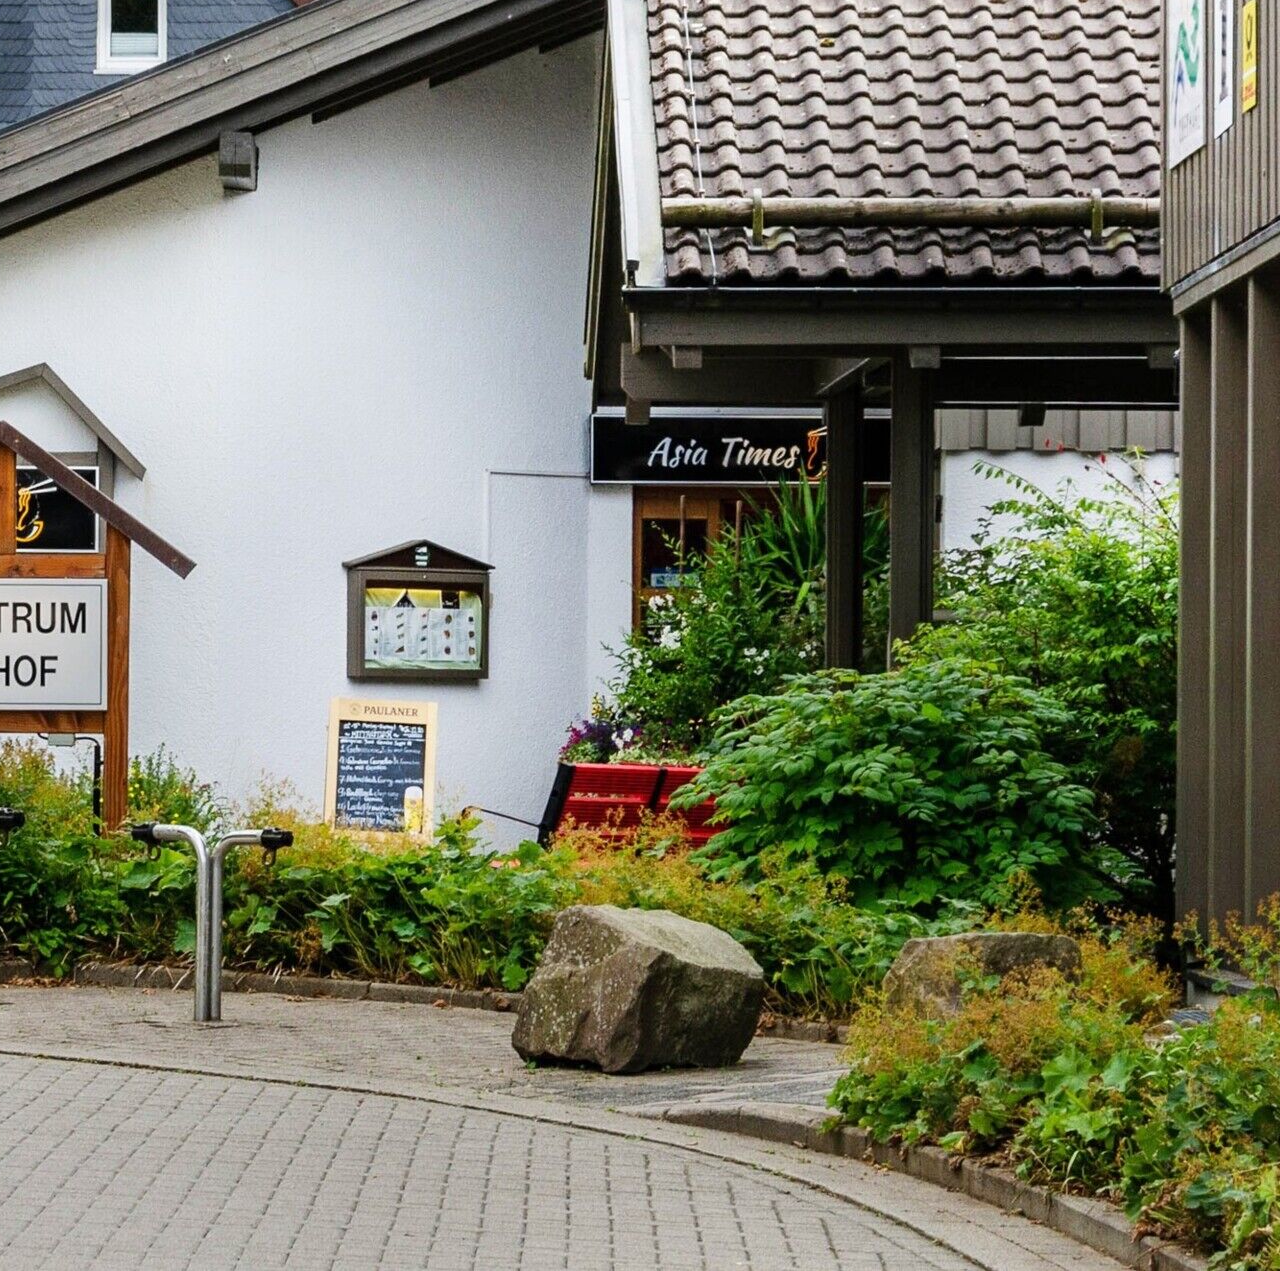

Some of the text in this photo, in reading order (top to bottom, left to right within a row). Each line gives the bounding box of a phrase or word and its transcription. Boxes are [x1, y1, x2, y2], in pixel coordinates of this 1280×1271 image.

[648, 436, 801, 471] Asia Times
[364, 705, 418, 717] PAULANER
